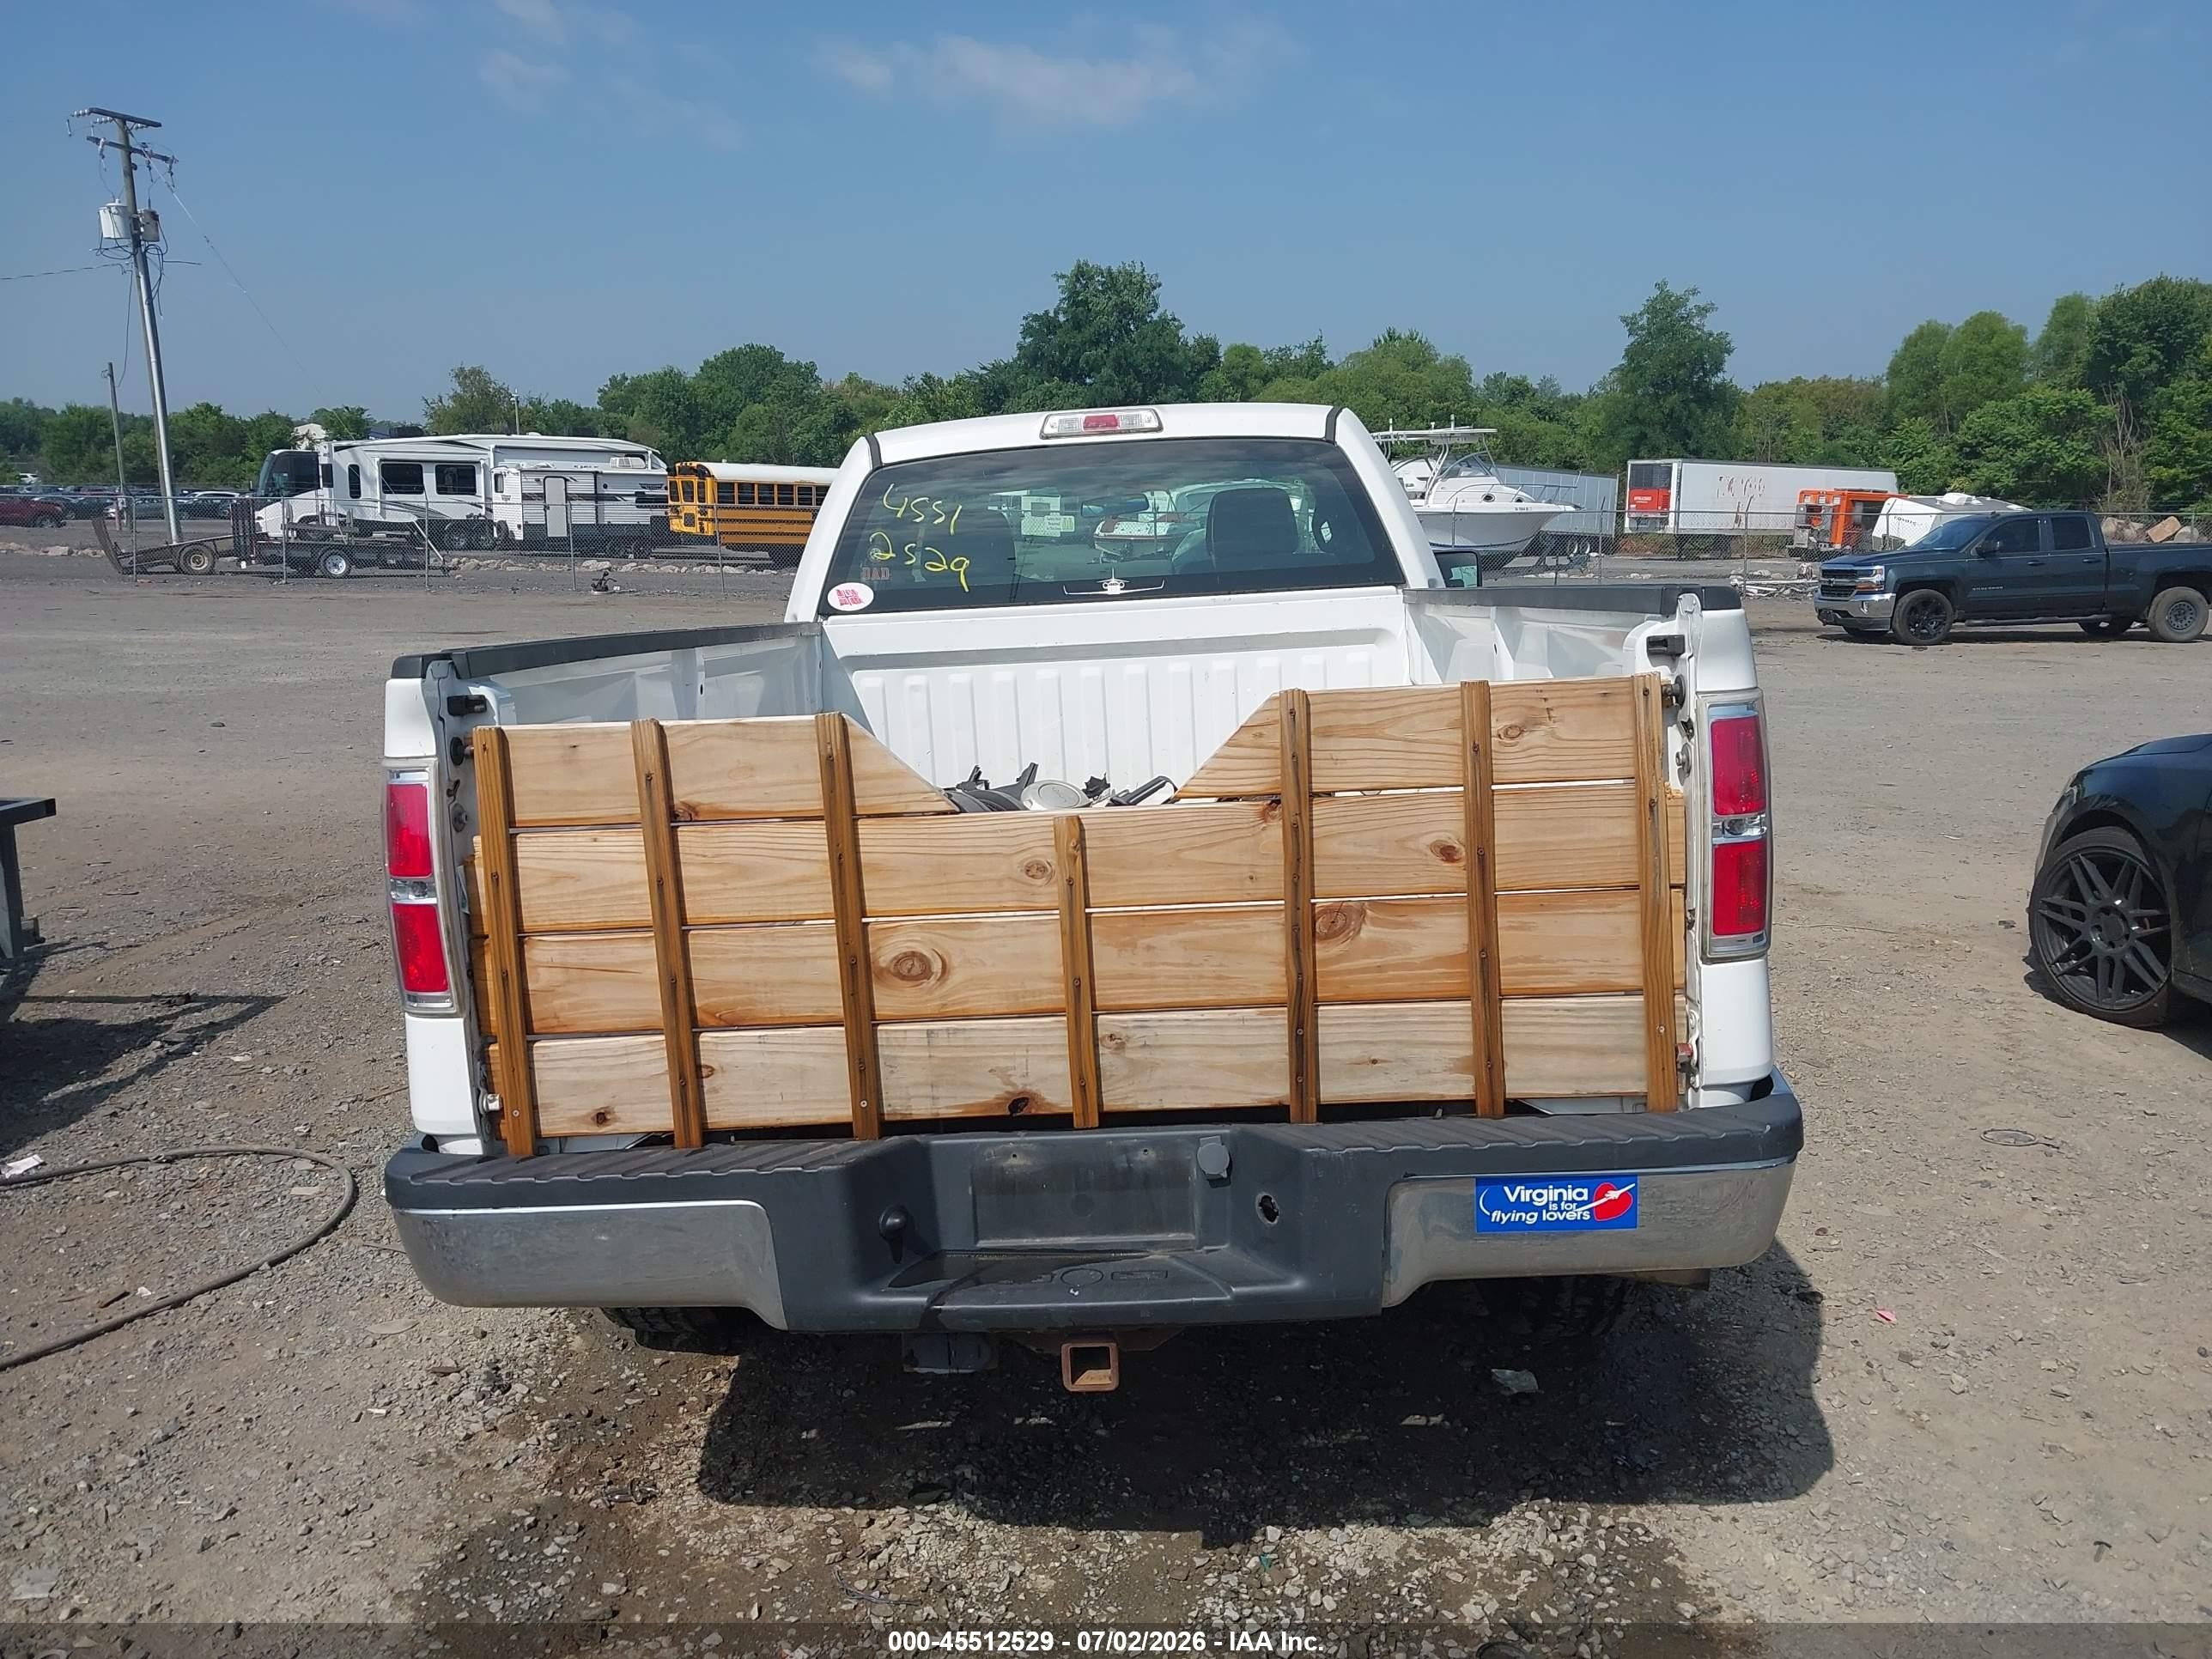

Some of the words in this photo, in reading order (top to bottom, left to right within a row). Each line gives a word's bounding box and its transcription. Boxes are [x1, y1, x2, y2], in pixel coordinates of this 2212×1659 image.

[883, 483, 963, 536] 4551
[869, 532, 970, 592] 2529
[1503, 1183, 1589, 1206] Virginia
[1548, 1201, 1559, 1211] is
[1559, 1201, 1578, 1211] for
[1491, 1210, 1538, 1224] flying
[1542, 1208, 1590, 1221] lovers
